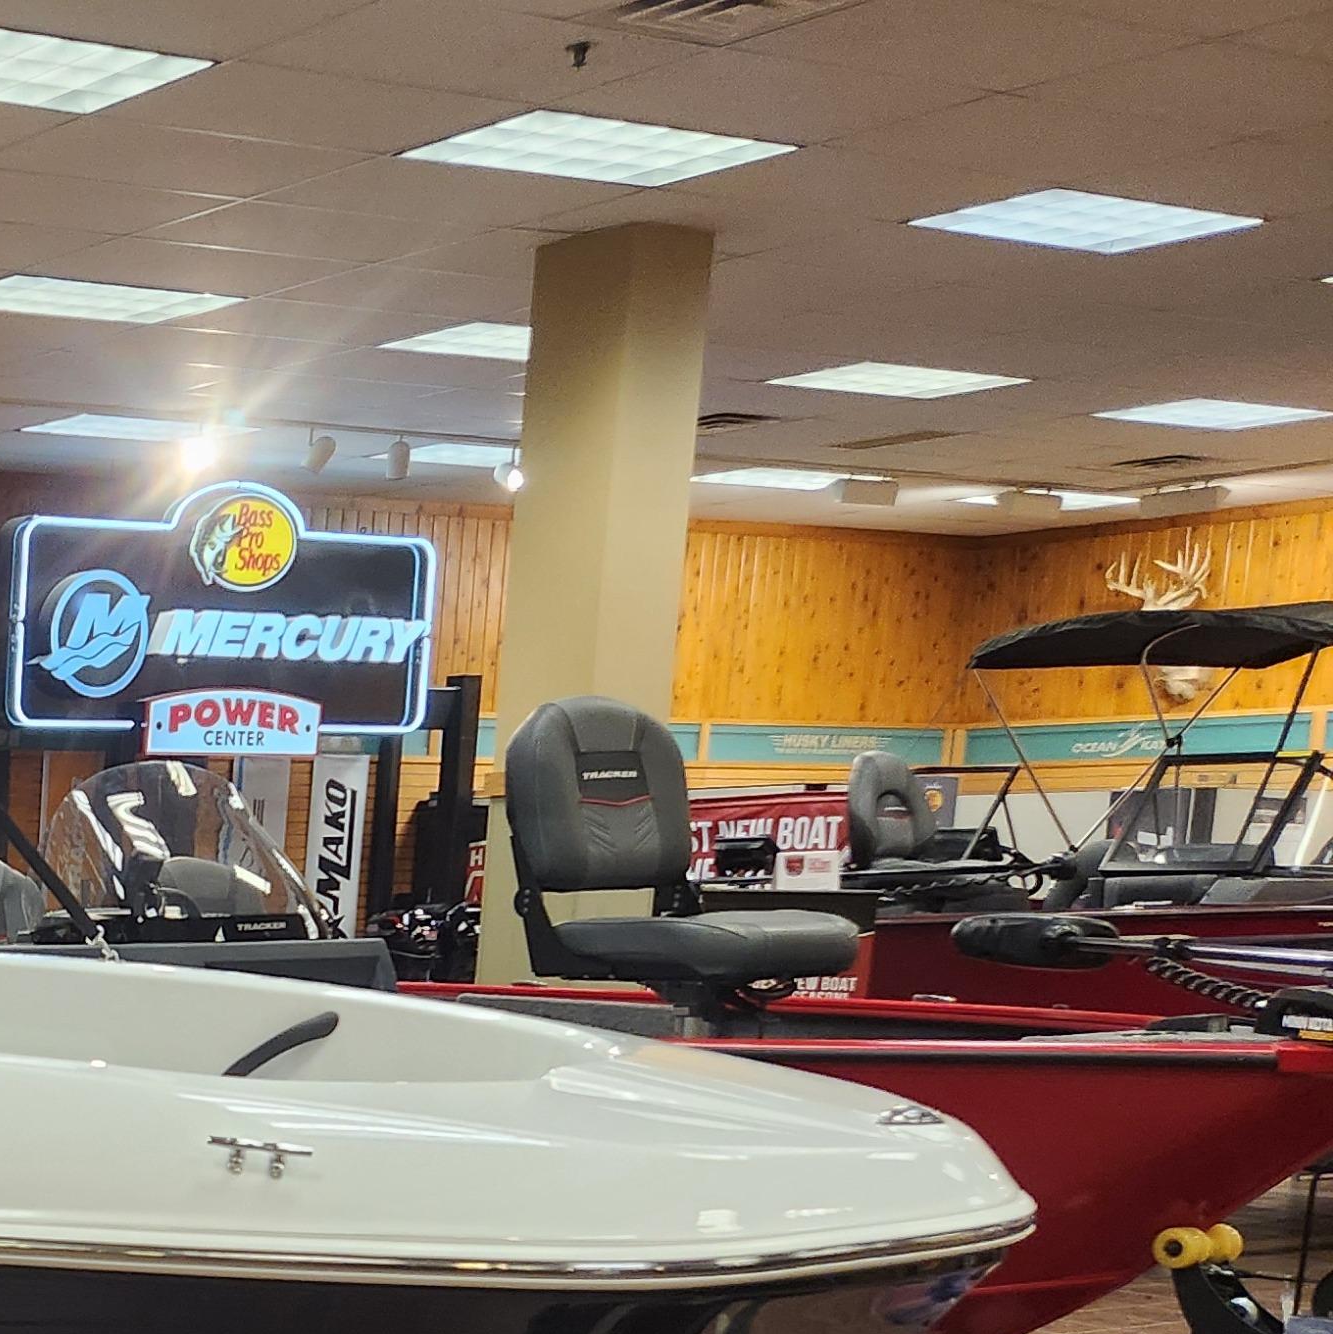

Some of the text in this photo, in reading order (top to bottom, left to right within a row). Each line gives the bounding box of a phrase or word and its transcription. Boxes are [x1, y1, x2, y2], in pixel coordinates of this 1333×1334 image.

[237, 503, 273, 529] Bass
[236, 527, 264, 548] Pro
[234, 548, 281, 577] Shops
[159, 609, 426, 663] MERCURY
[167, 697, 300, 735] POWER
[203, 730, 265, 748] CENTER
[783, 735, 829, 748] HUSKY
[1072, 742, 1117, 753] OCEAN
[582, 770, 638, 780] TRACKER
[776, 816, 844, 850] BOAT
[316, 778, 357, 916] MAKO
[236, 921, 287, 931] TRACKER
[820, 976, 858, 992] BOAT
